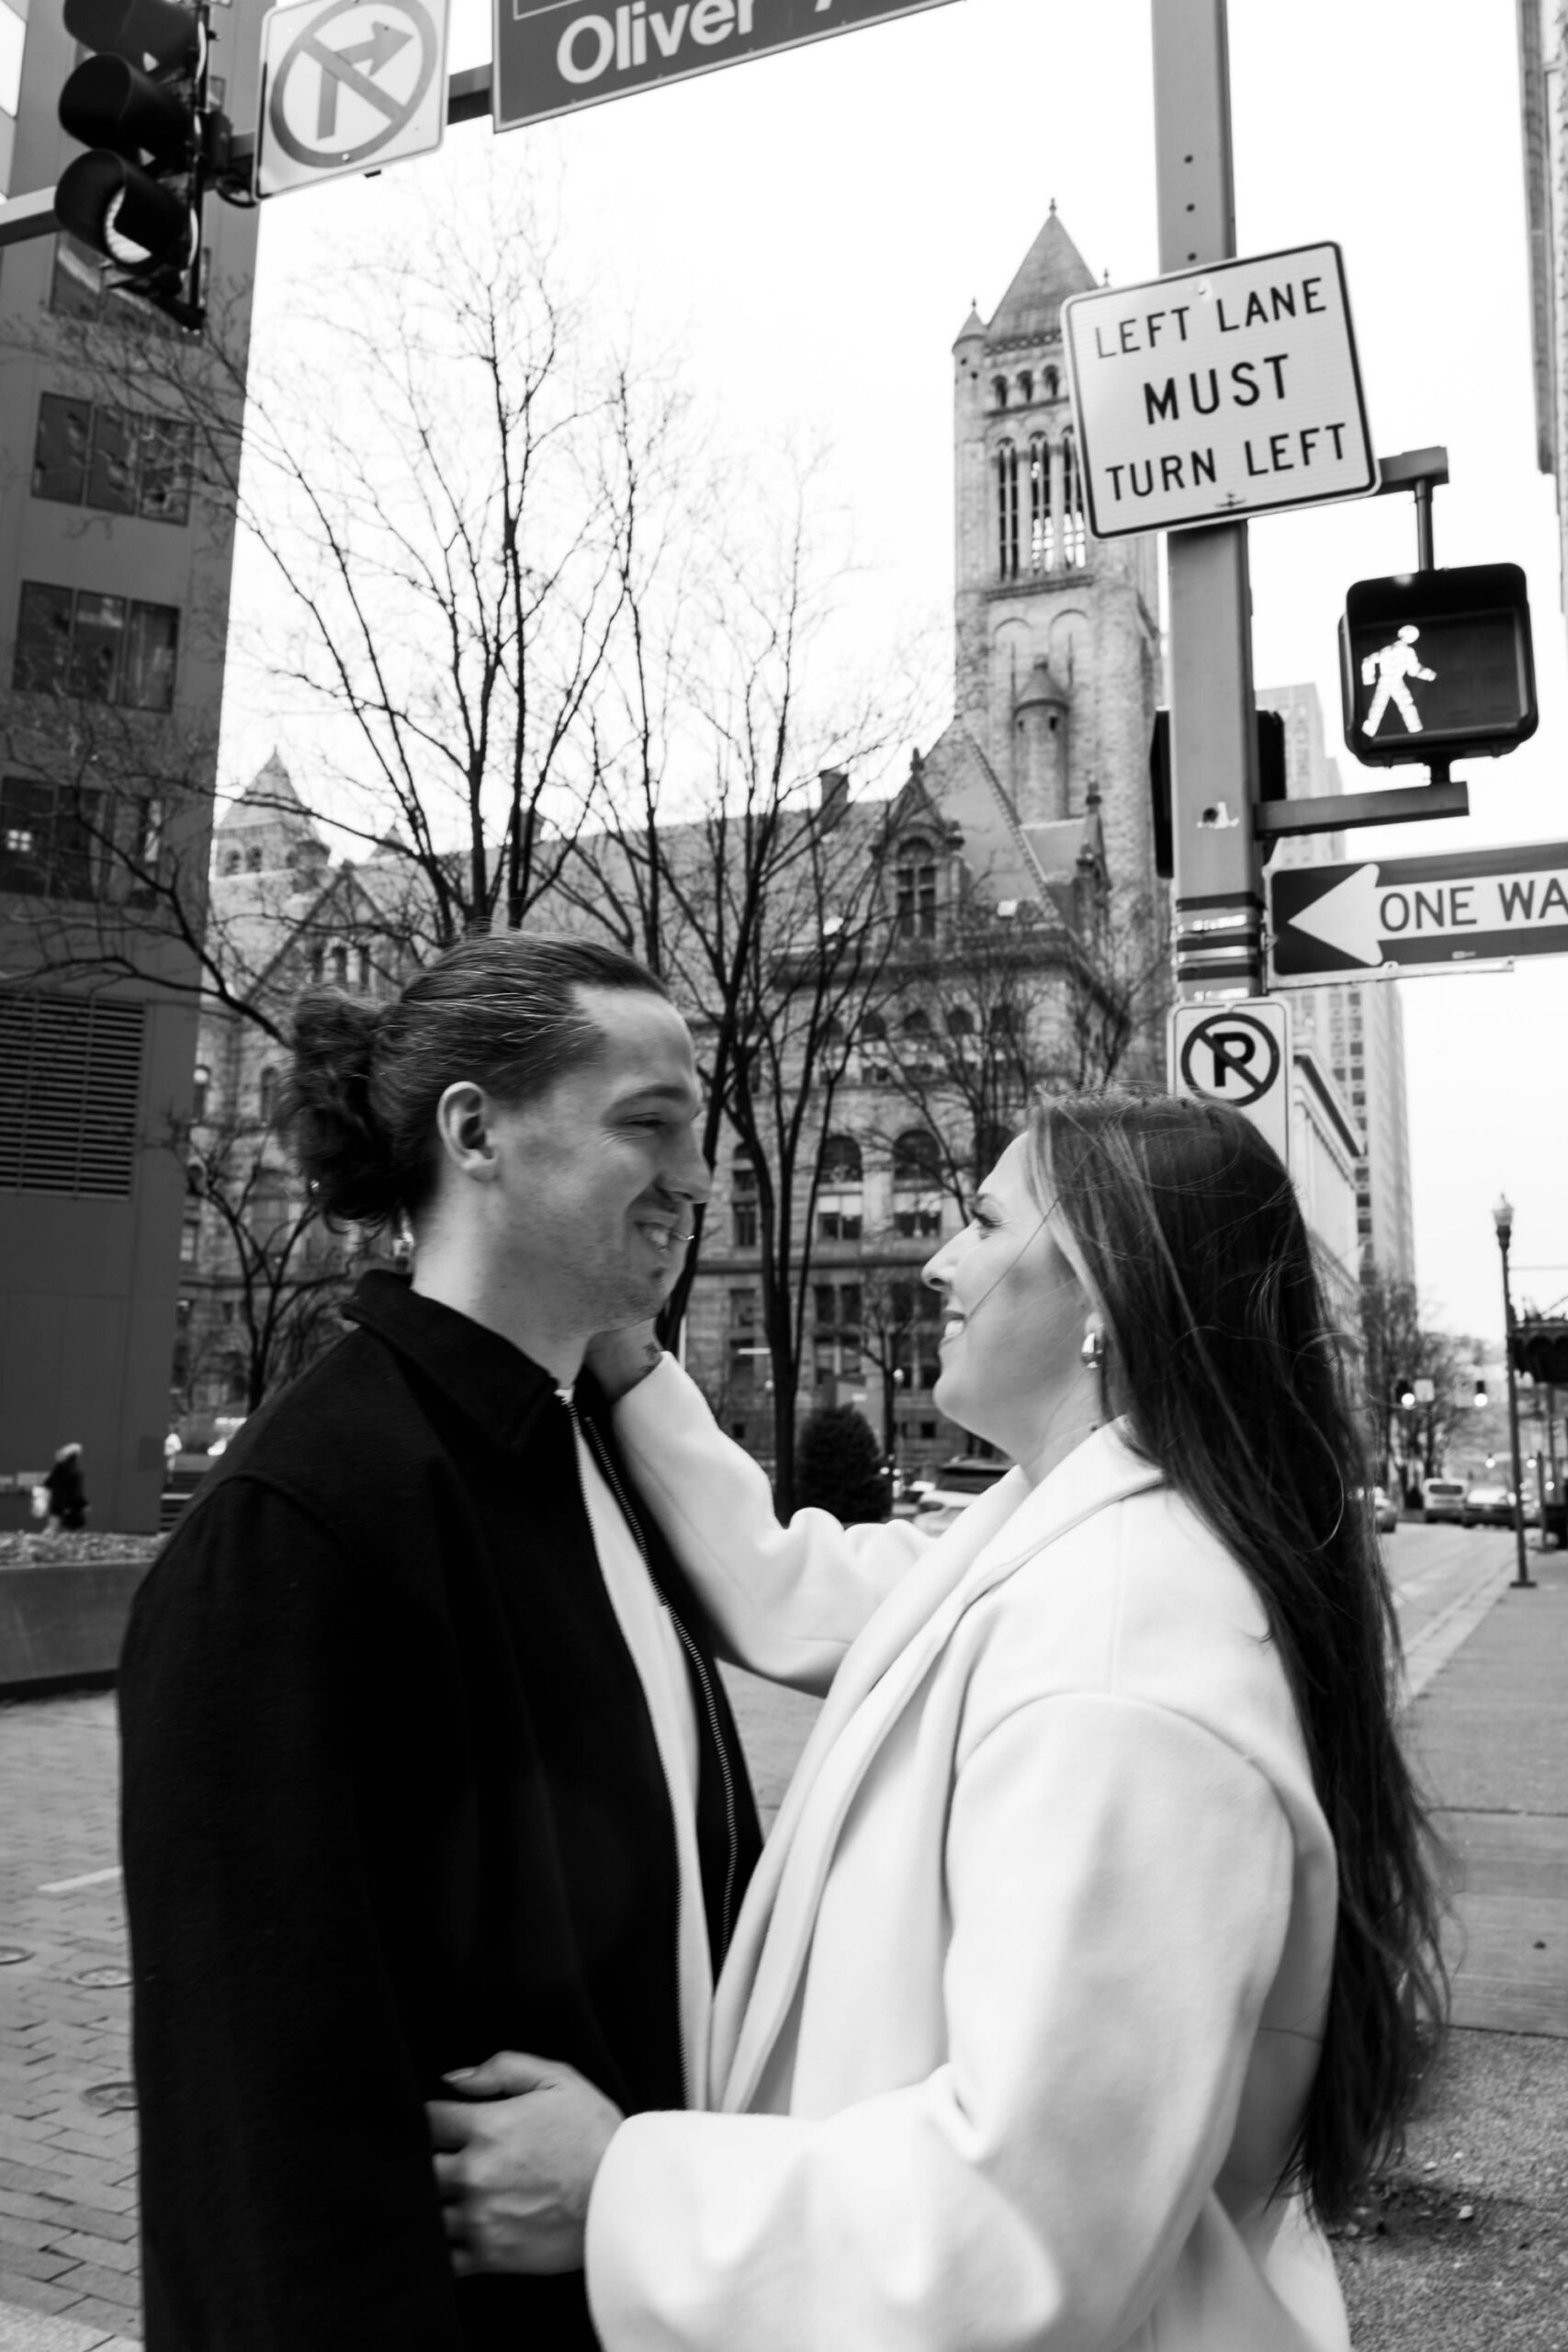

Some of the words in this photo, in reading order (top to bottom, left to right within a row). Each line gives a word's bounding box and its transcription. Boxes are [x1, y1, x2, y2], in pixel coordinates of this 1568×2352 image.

[557, 0, 754, 84] Oliver
[1096, 306, 1190, 358] LEFT
[1217, 277, 1325, 332] LANE
[1144, 354, 1288, 424] MUST
[1105, 447, 1216, 501] TURN
[1246, 423, 1345, 476] LEFT
[1381, 887, 1477, 932] ONE
